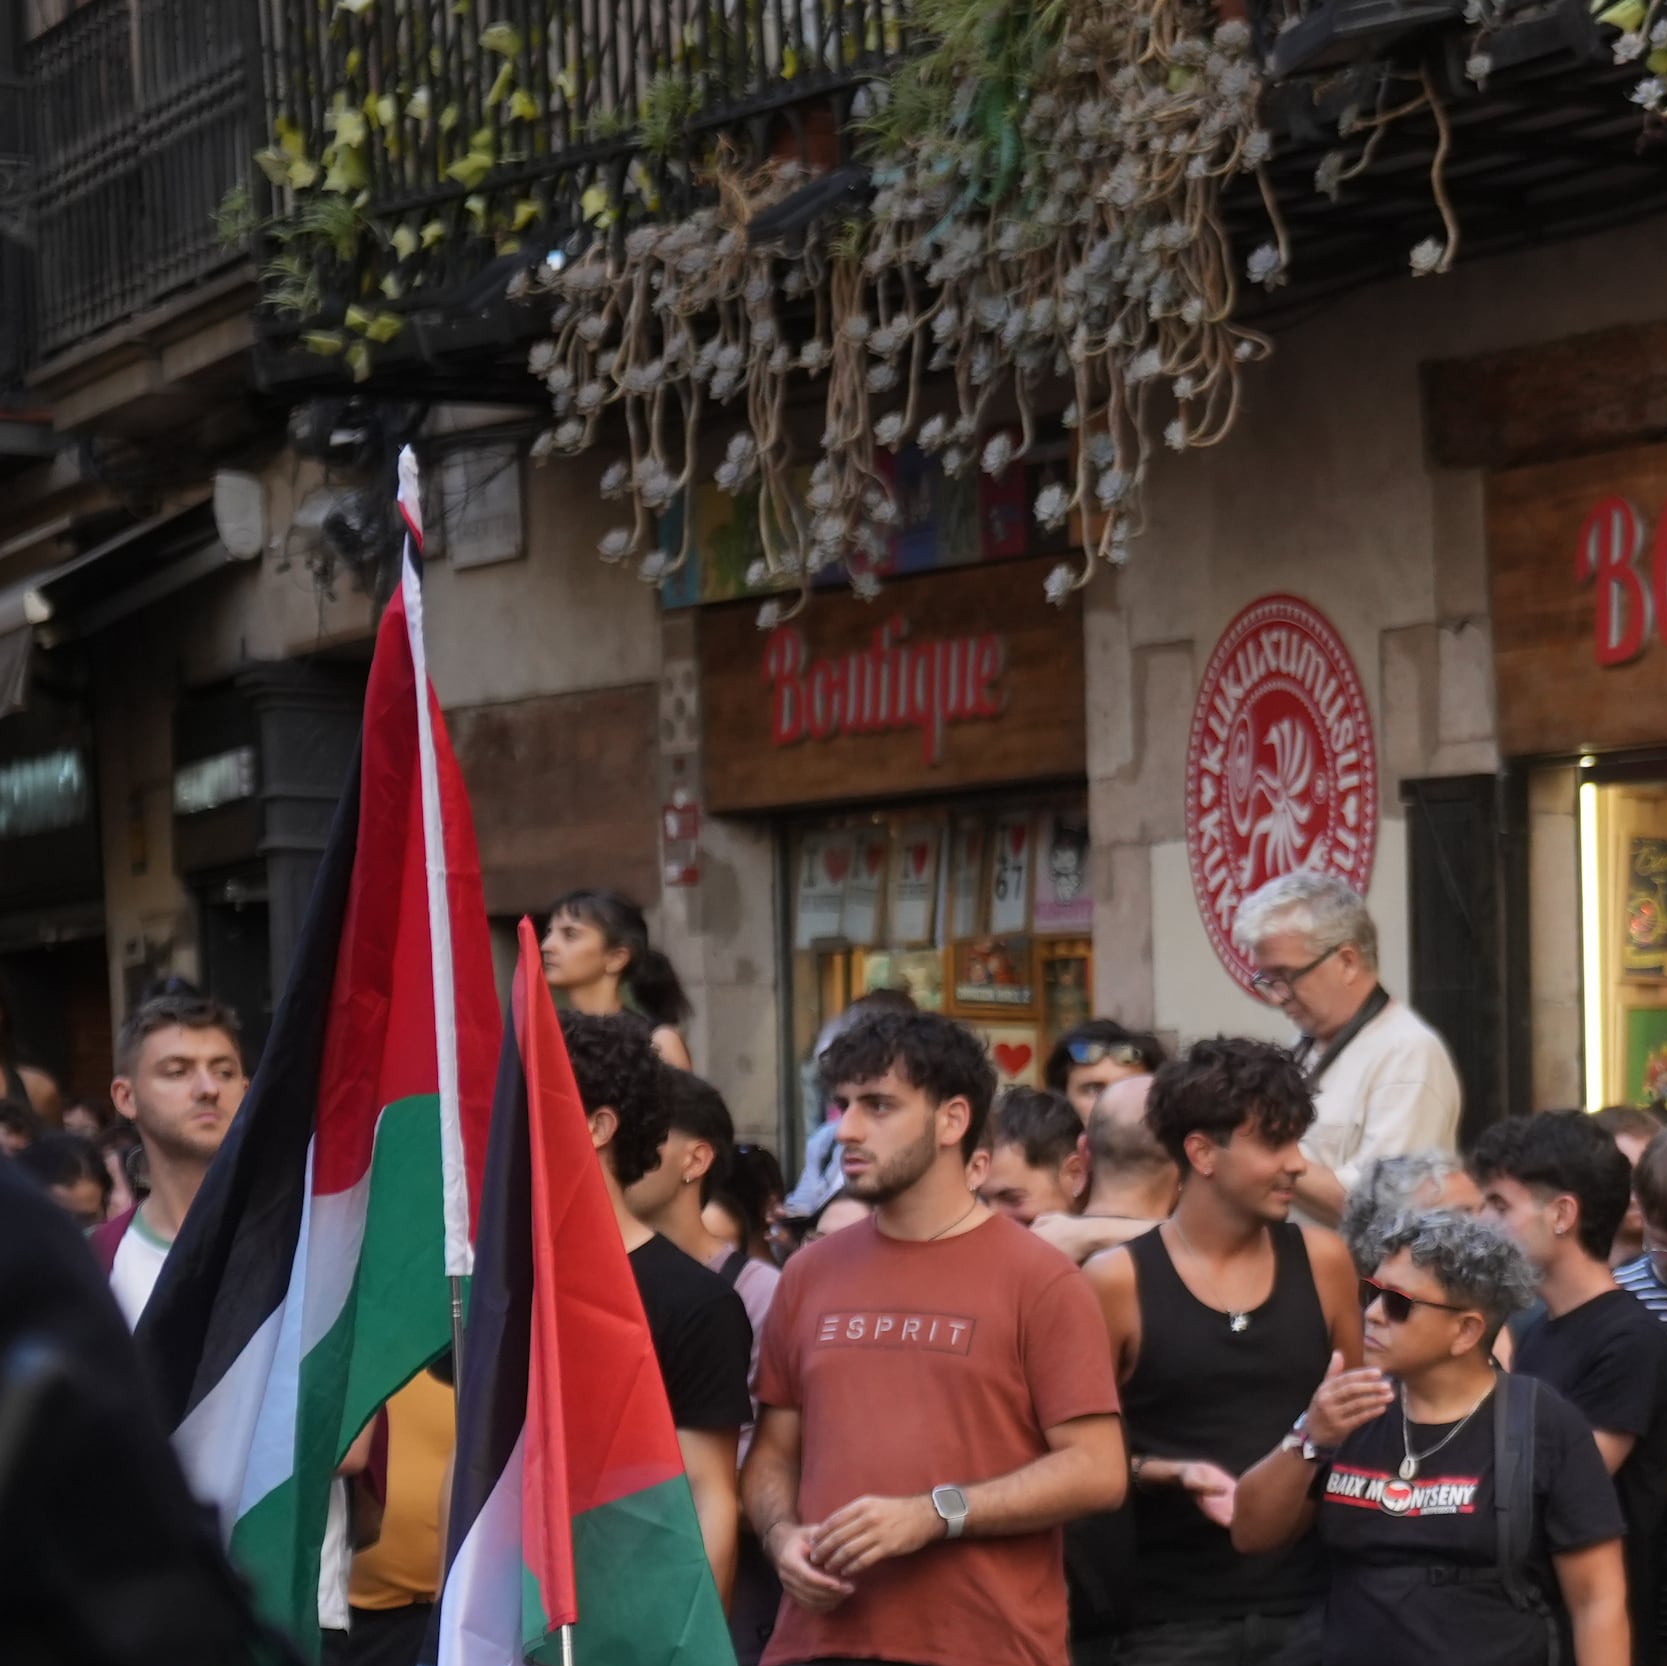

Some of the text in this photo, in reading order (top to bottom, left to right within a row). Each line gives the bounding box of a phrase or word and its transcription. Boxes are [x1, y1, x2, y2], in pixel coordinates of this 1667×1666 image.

[763, 614, 1005, 765] Boutique
[819, 1314, 967, 1346] ESPRIT
[1326, 1472, 1366, 1498] BAIX
